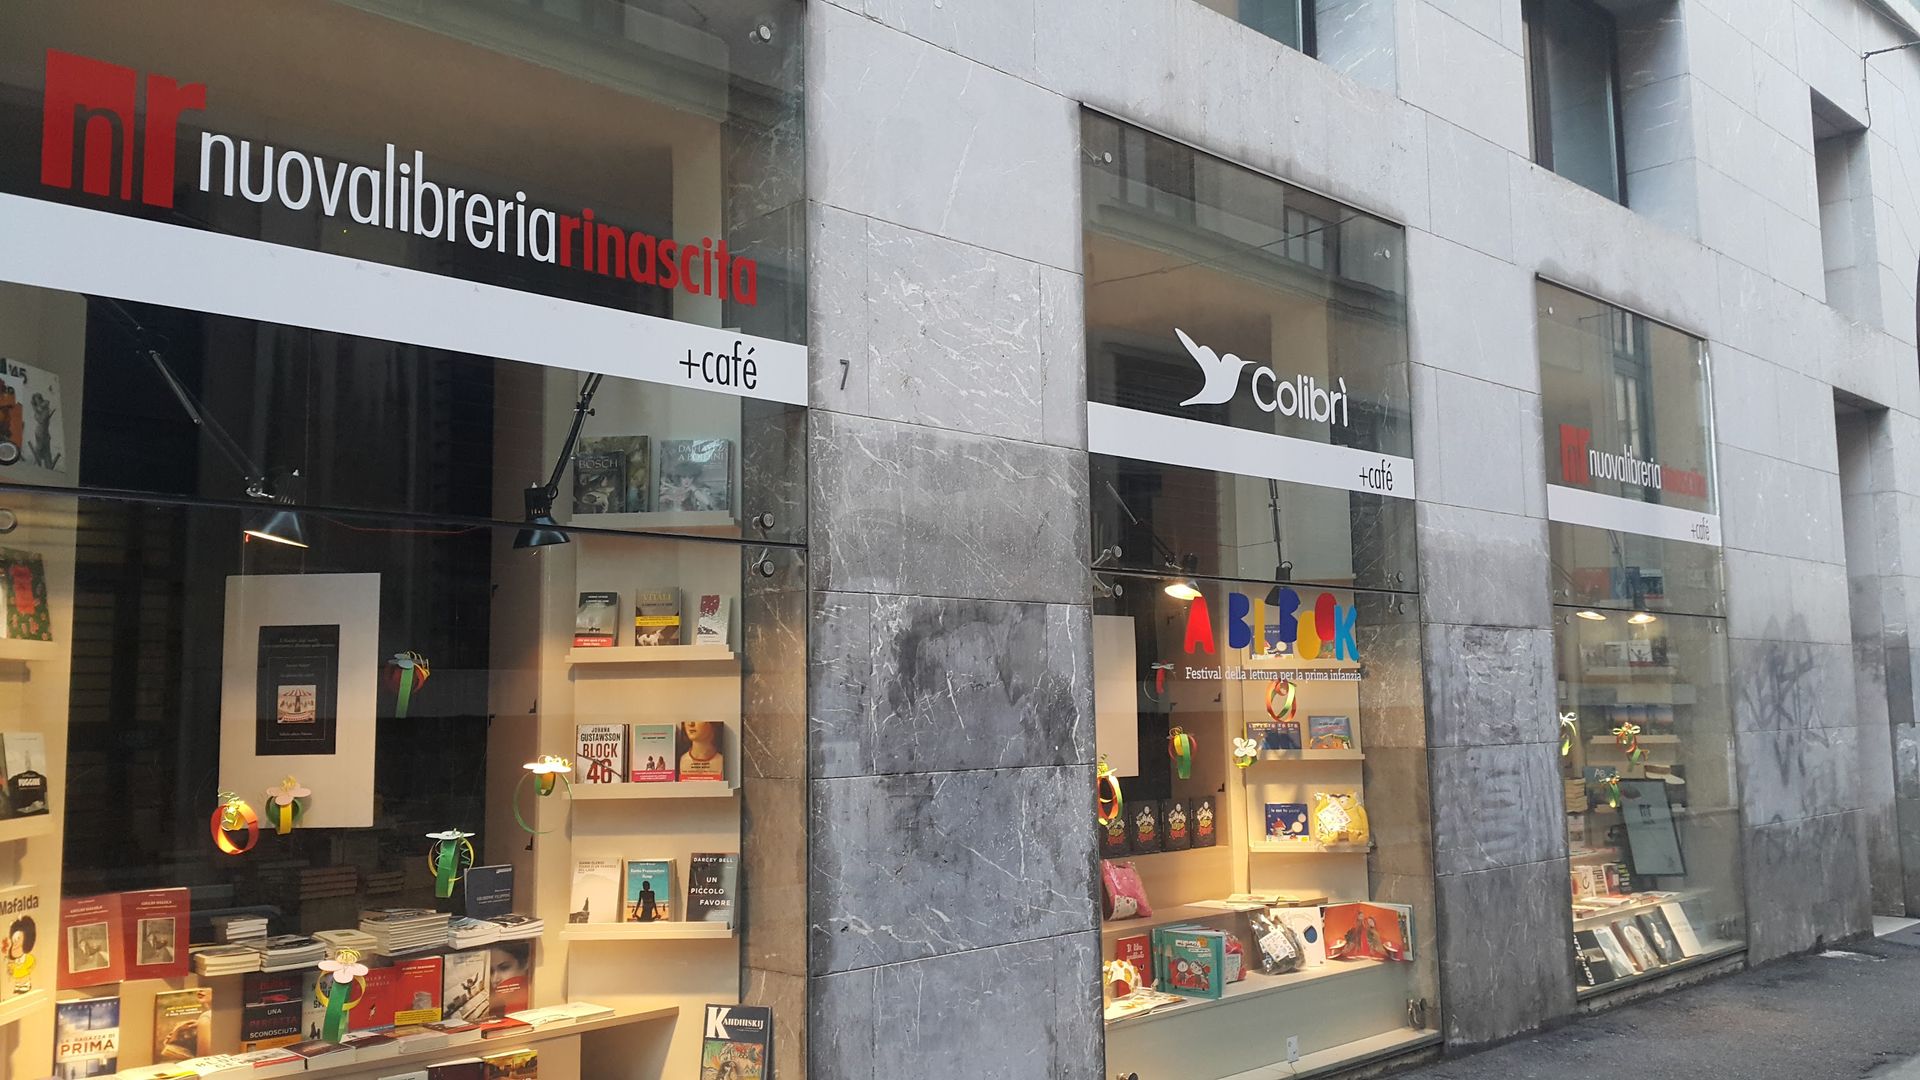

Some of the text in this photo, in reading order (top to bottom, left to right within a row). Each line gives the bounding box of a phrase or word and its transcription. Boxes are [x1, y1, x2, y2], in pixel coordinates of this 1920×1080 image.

[839, 358, 850, 390] 7
[1251, 366, 1349, 427] Colibrì
[578, 459, 618, 470] BOSCH
[1184, 595, 1216, 655] A
[1185, 666, 1362, 684] Festival della lettura per la prima infanzia
[580, 732, 621, 742] GUSTAWSSON
[582, 743, 618, 759] BLOCK
[586, 758, 612, 784] 46
[690, 887, 724, 895] PICCOLO
[0, 895, 39, 915] Mafalda
[249, 1028, 298, 1039] SCONOSCIUTA
[61, 1039, 114, 1056] PRIMA
